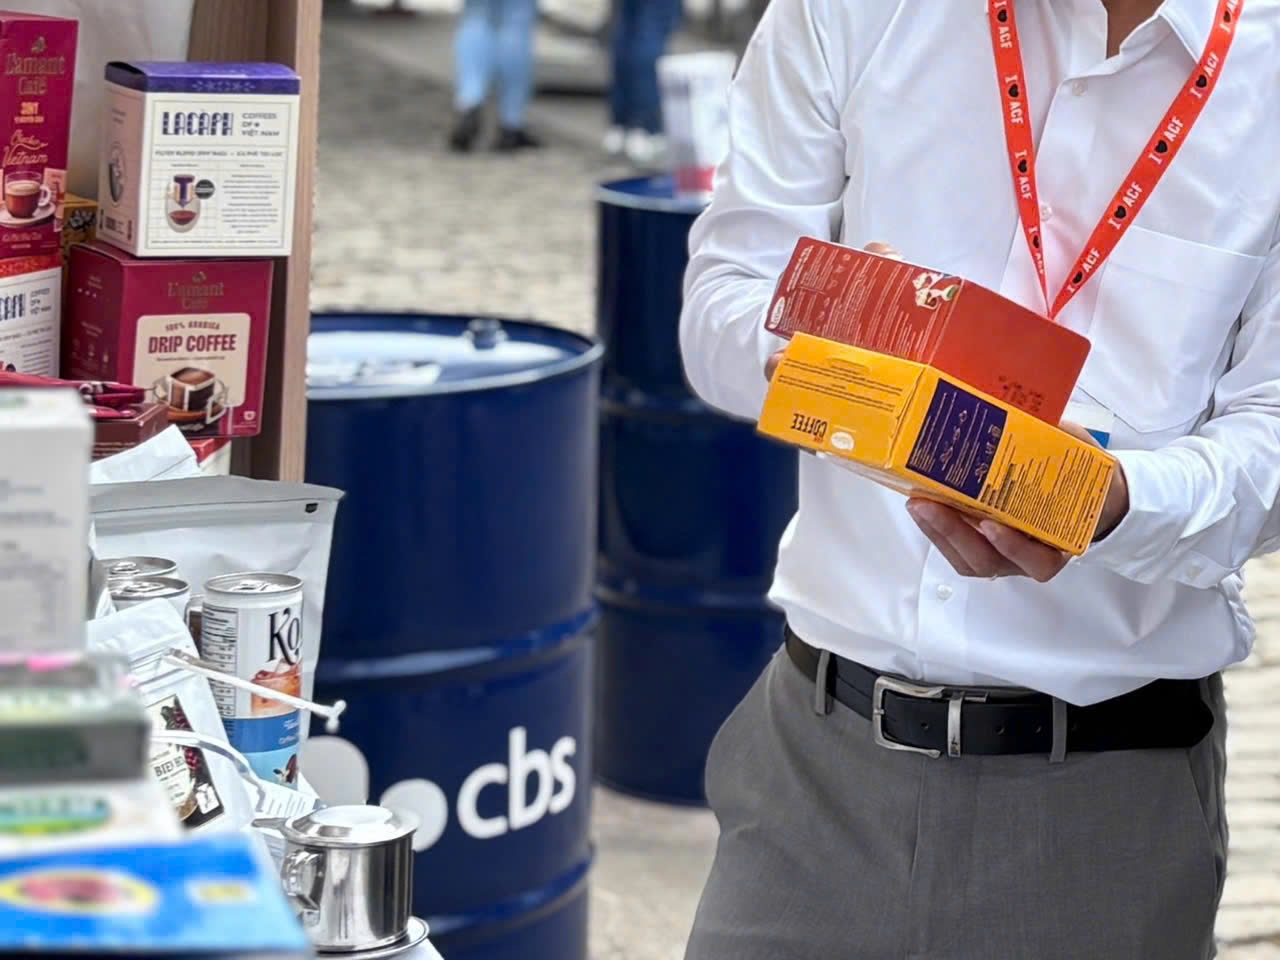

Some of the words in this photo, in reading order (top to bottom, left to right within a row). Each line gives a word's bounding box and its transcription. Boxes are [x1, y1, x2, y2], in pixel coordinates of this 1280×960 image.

[994, 0, 1007, 8] I
[998, 26, 1012, 48] ACF
[1219, 23, 1231, 34] I
[1005, 74, 1018, 83] I
[1190, 87, 1202, 99] I
[1009, 101, 1024, 125] ACF
[1148, 153, 1162, 165] I
[1163, 115, 1184, 142] ACF
[1015, 149, 1027, 158] I
[1018, 176, 1032, 200] ACF
[1108, 218, 1121, 230] I
[1122, 181, 1143, 207] ACF
[1081, 247, 1100, 273] ACF
[148, 335, 183, 354] DRIP
[185, 334, 237, 352] COFFEE
[790, 413, 828, 437] COFFEE
[456, 726, 577, 840] cbs
